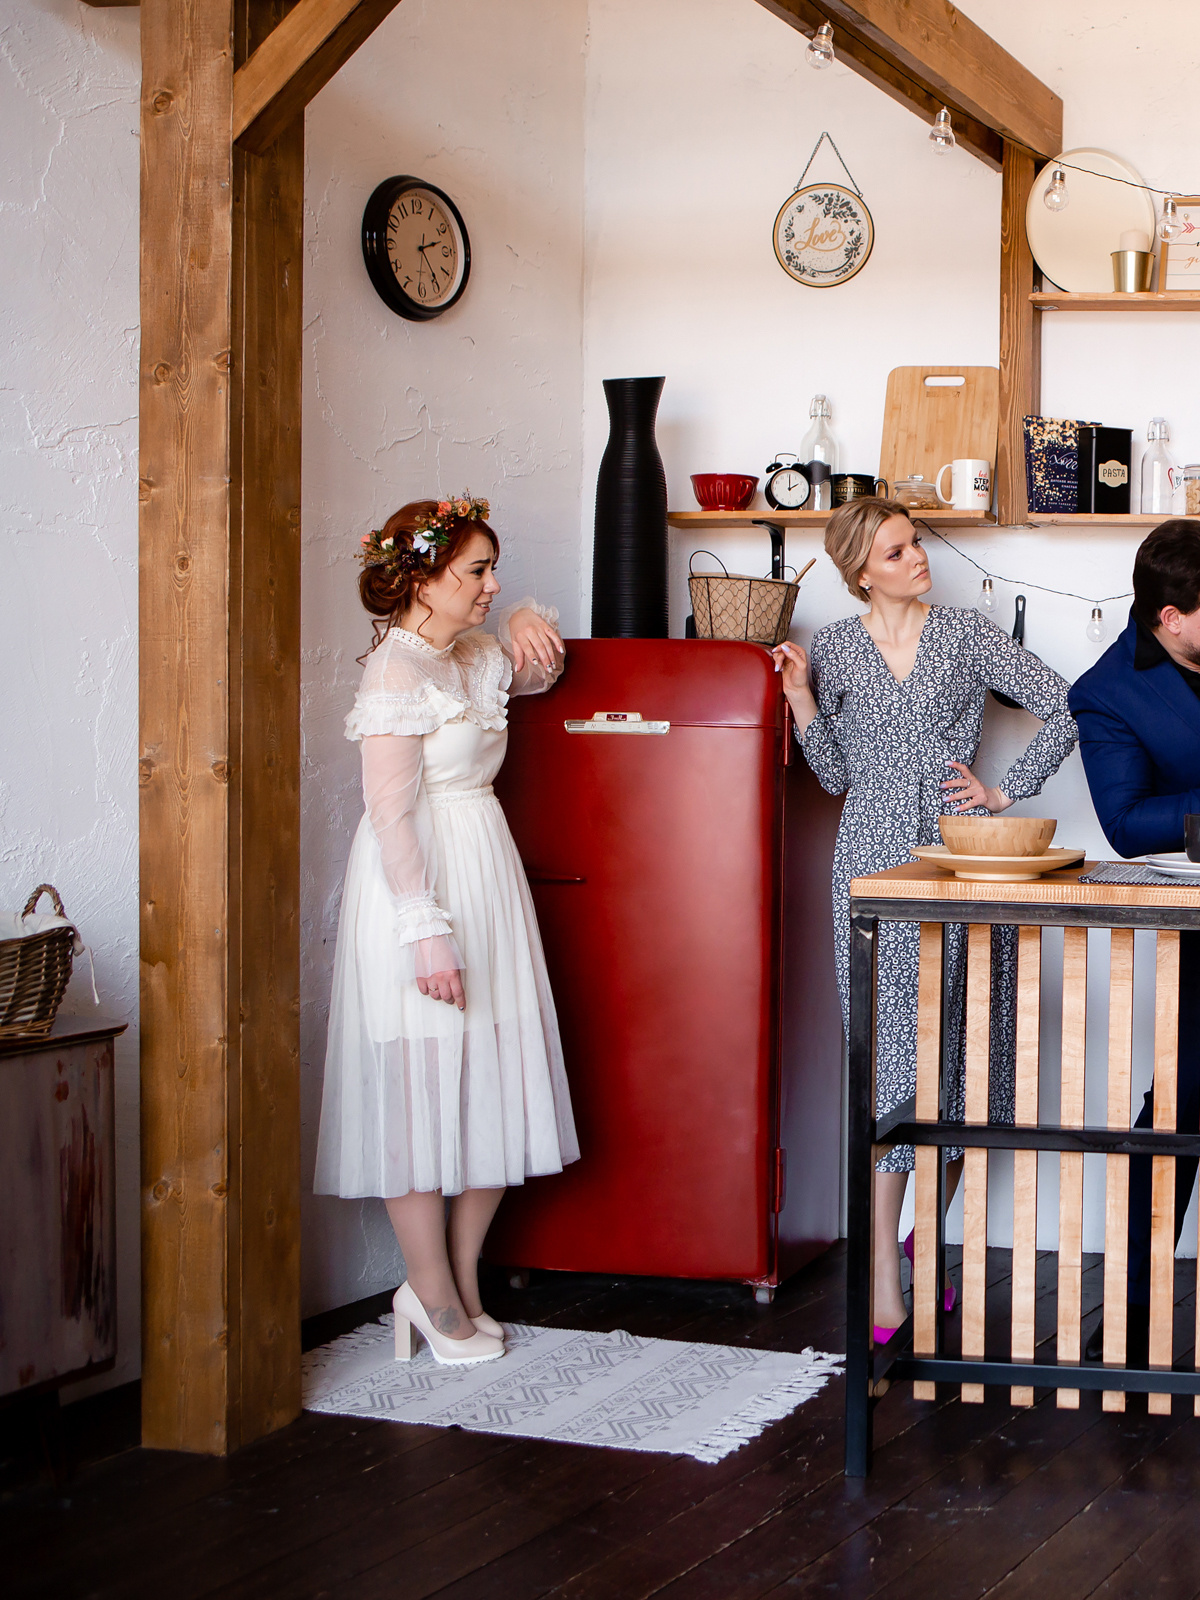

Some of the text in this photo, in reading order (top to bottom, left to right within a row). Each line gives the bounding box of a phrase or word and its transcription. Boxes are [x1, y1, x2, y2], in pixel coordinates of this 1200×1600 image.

[397, 202, 409, 220] 11
[411, 199, 423, 215] 12
[428, 208, 435, 221] 1
[387, 214, 401, 233] 10
[436, 222, 448, 237] 2
[794, 217, 847, 252] Love
[387, 238, 398, 250] 9
[441, 245, 453, 258] 3
[391, 259, 403, 274] 8
[403, 275, 413, 289] 7
[418, 282, 427, 298] 6
[1102, 468, 1126, 478] PASTA
[973, 477, 989, 485] STEP
